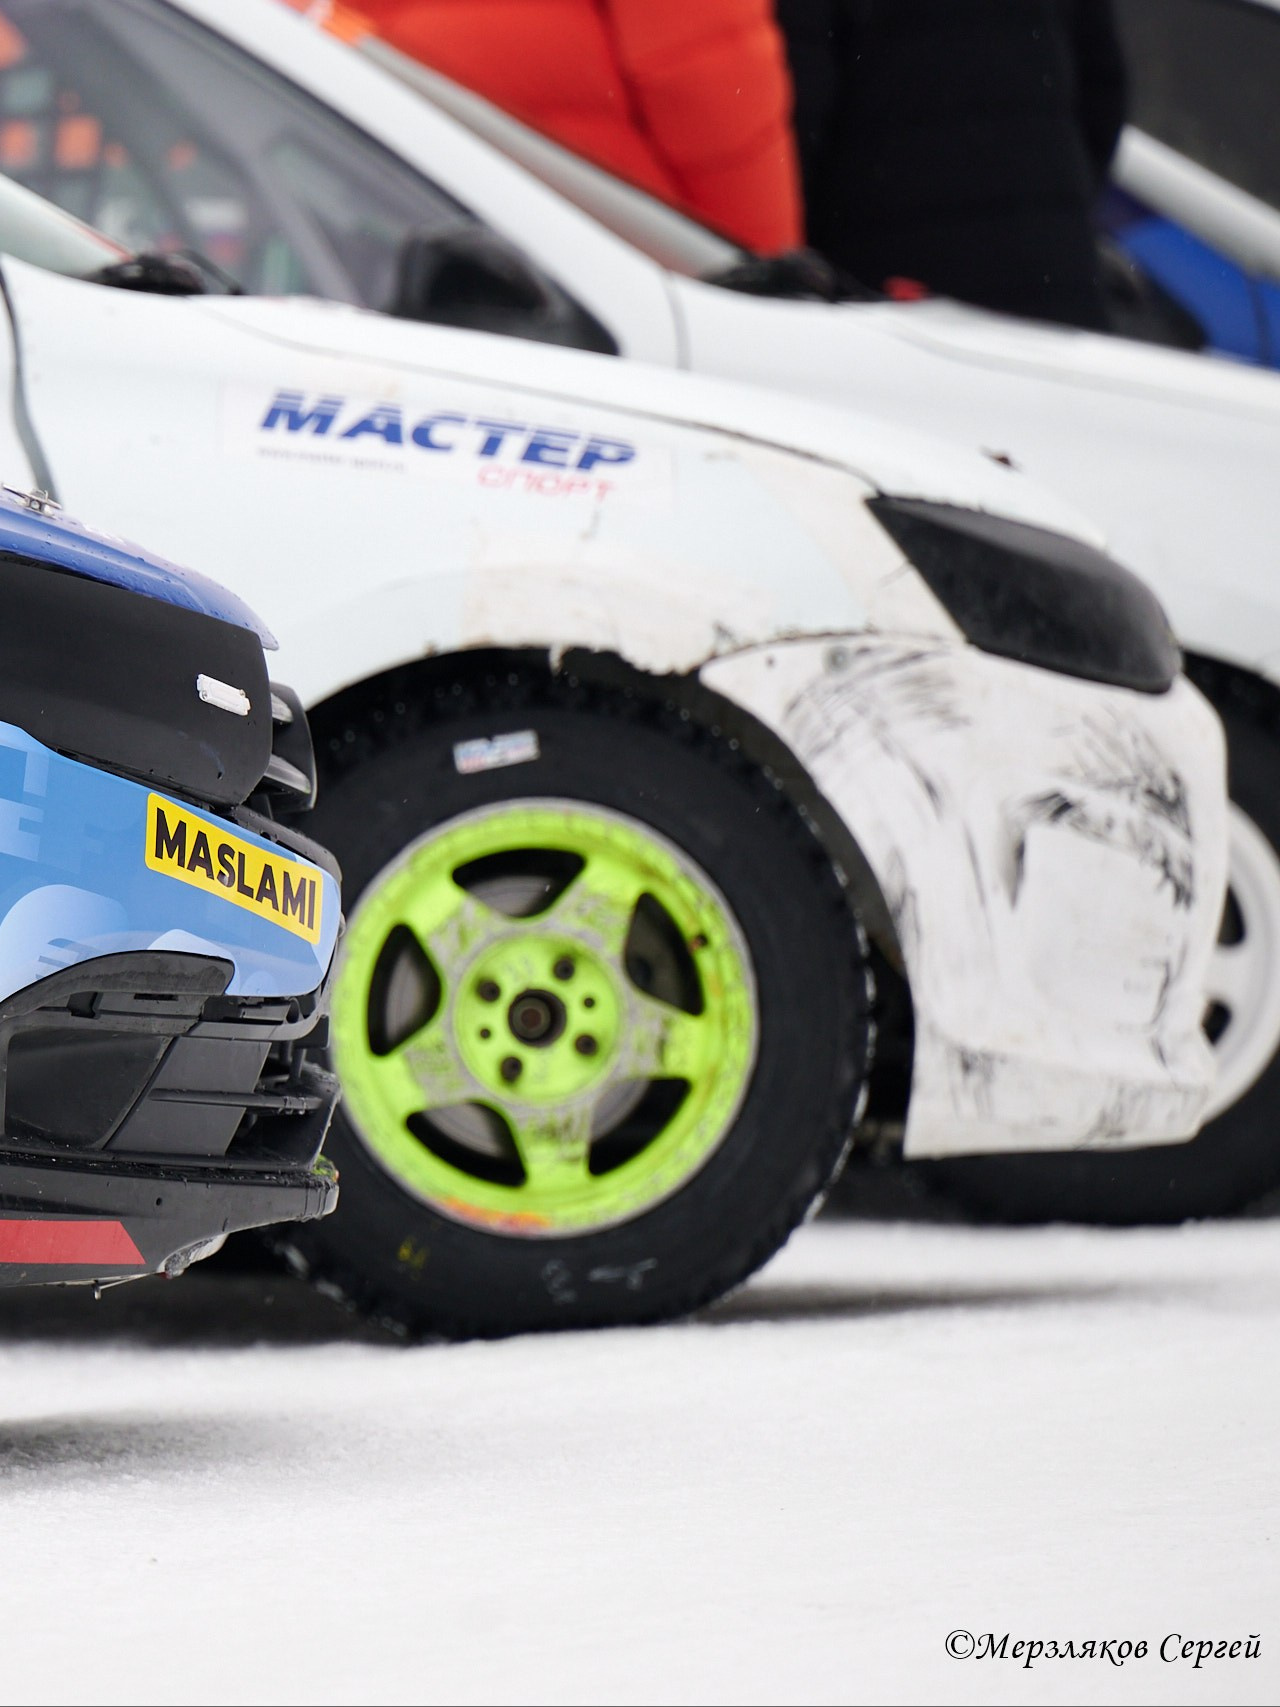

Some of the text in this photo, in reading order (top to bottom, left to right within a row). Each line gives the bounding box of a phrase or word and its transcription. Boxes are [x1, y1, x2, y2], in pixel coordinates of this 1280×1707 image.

[260, 388, 637, 471] МАСТЕР
[477, 463, 617, 503] СПОРТ
[154, 806, 317, 930] MASLAMI
